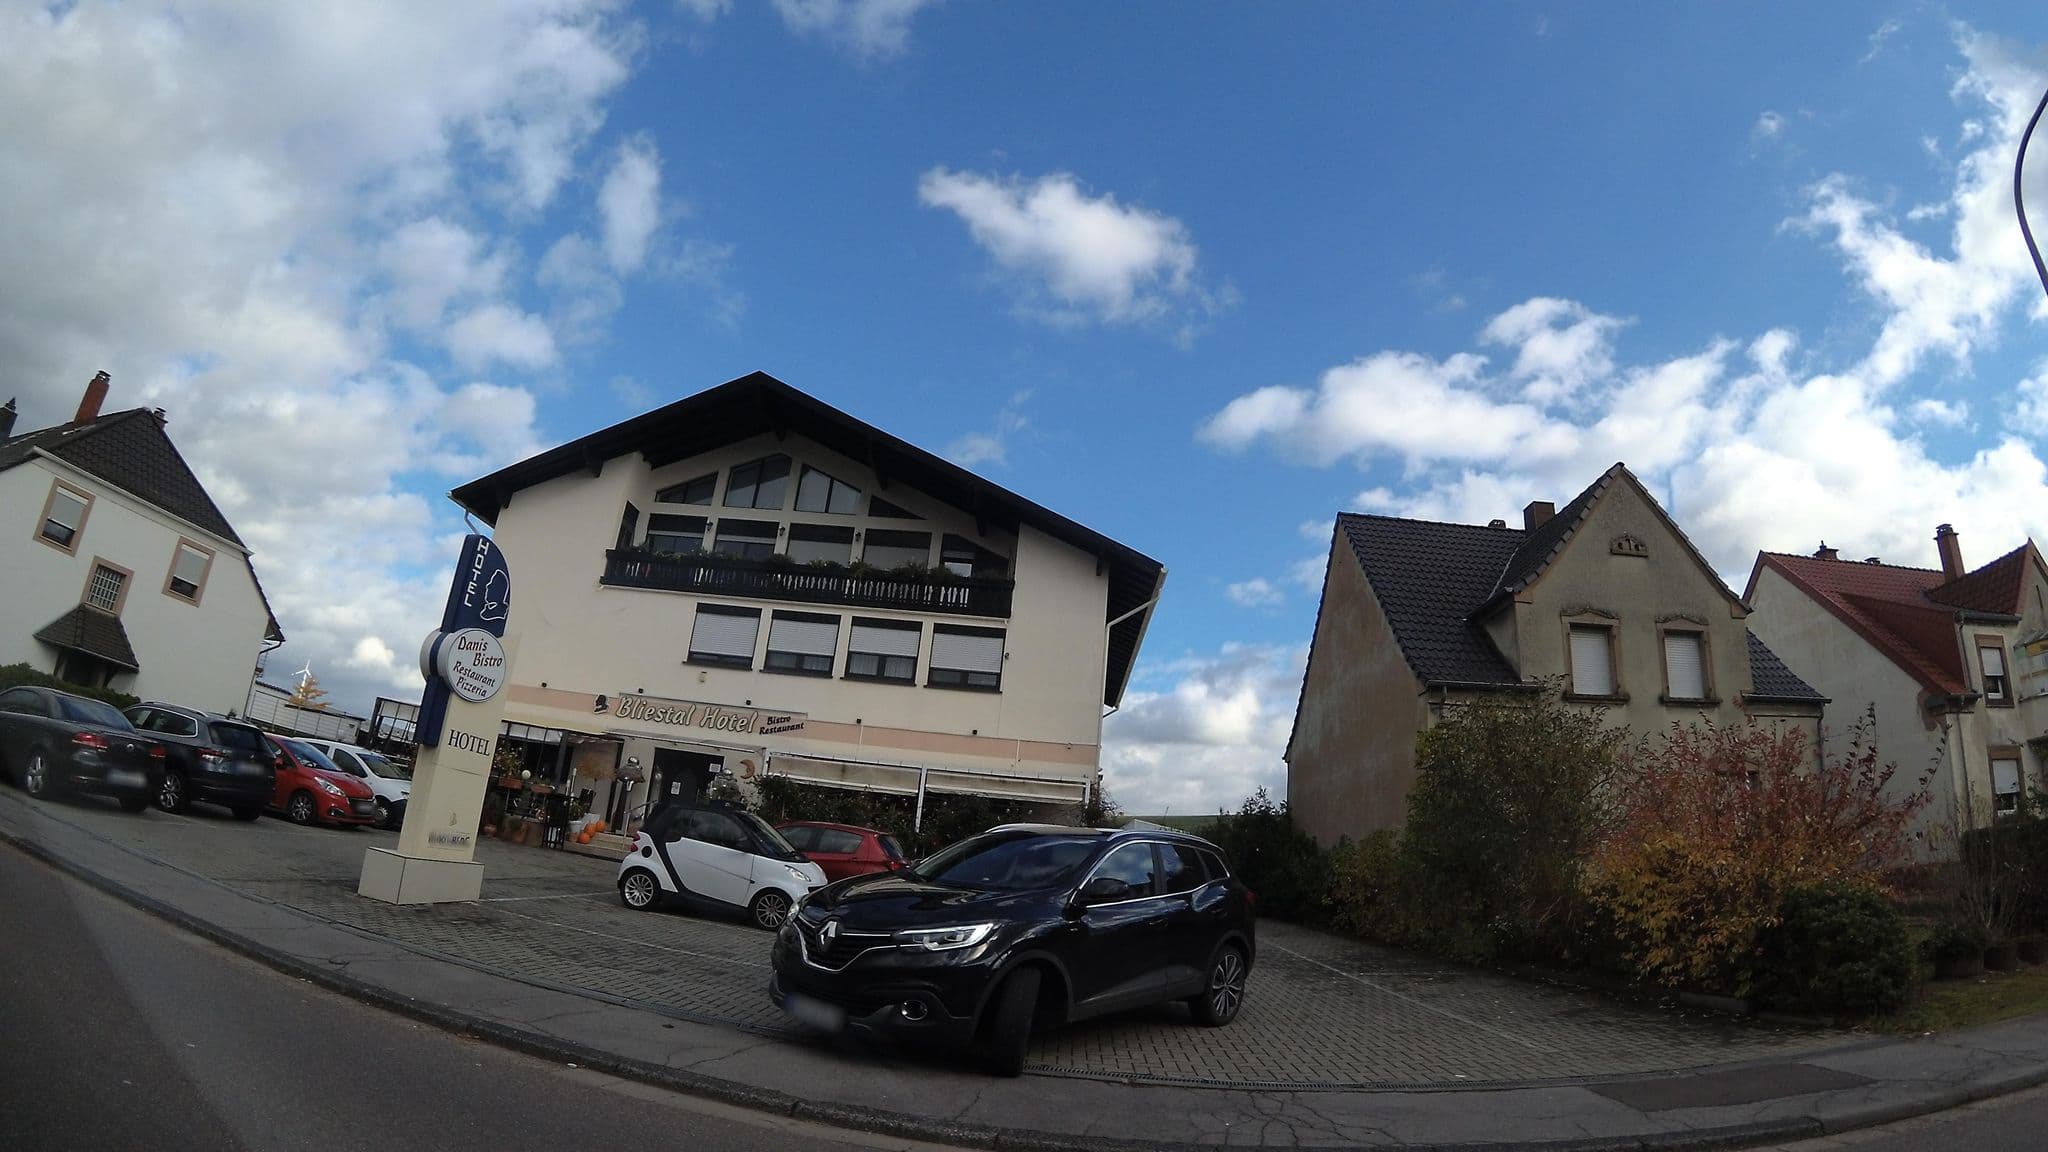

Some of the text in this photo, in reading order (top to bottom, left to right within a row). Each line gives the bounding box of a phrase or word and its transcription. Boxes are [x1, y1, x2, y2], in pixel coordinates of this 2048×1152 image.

[464, 538, 490, 607] HOTEL
[458, 636, 488, 651] Danis
[473, 652, 503, 667] Bistro
[453, 661, 496, 687] Restaurant
[456, 676, 487, 698] Pizzeria
[616, 696, 759, 733] Bliestal Hotel
[767, 716, 791, 726] Bistro
[759, 722, 804, 735] Restaurant
[448, 729, 490, 756] HOTEL
